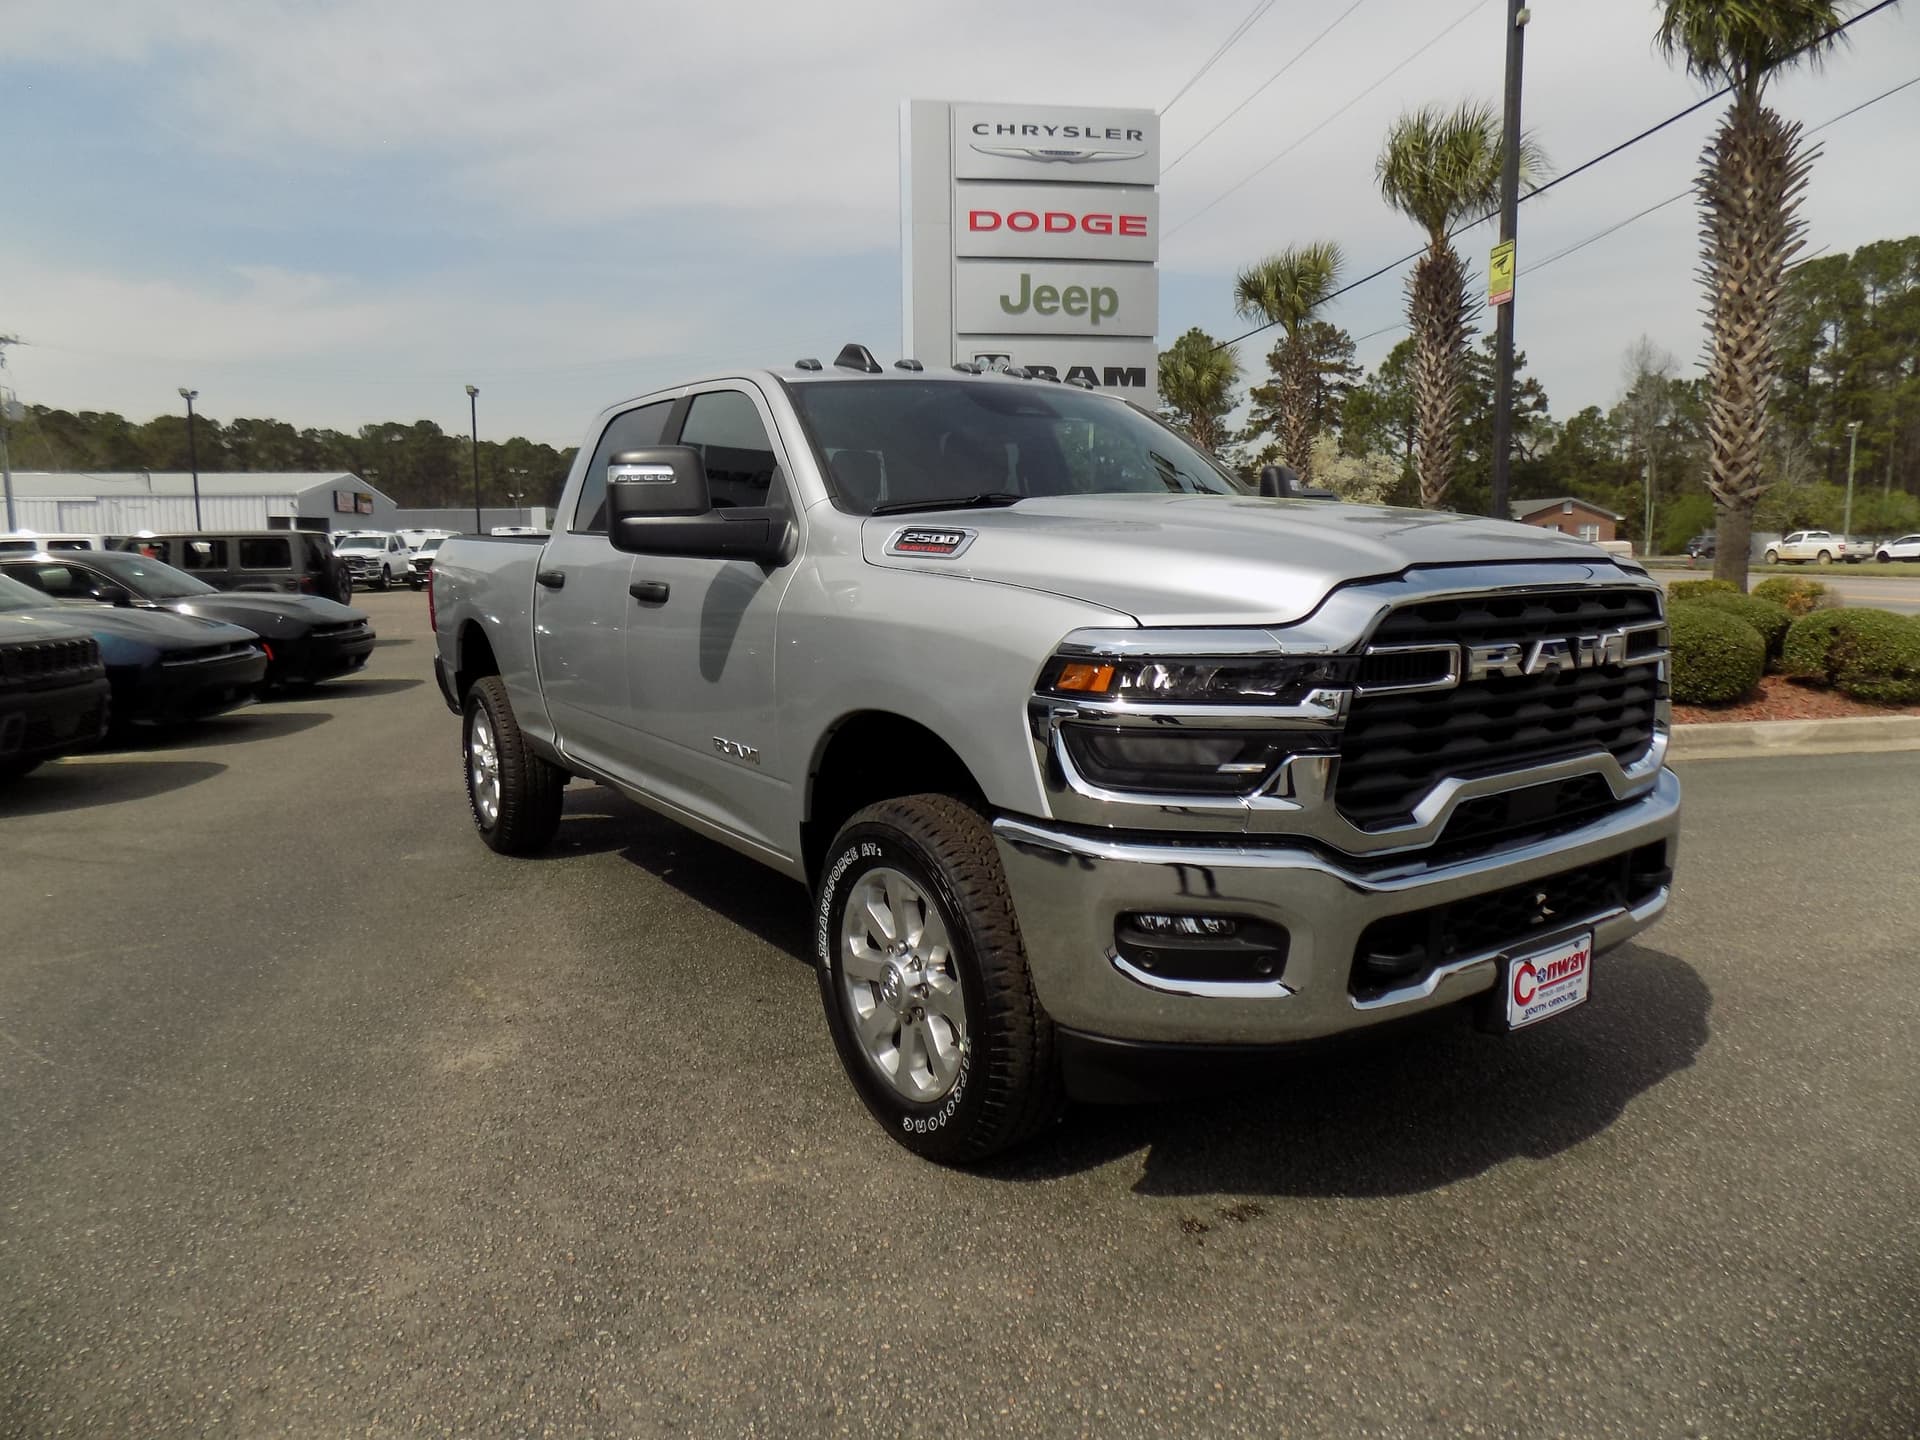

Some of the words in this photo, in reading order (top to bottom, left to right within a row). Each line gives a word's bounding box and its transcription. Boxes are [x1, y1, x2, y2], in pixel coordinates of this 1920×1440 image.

[972, 124, 1143, 142] CHRYSLER
[969, 210, 1148, 237] DODGE
[999, 273, 1119, 326] Jeep
[1024, 365, 1146, 388] RAM
[903, 533, 960, 545] 2500
[1468, 634, 1626, 681] RAM
[818, 846, 860, 958] TRANSFORCE
